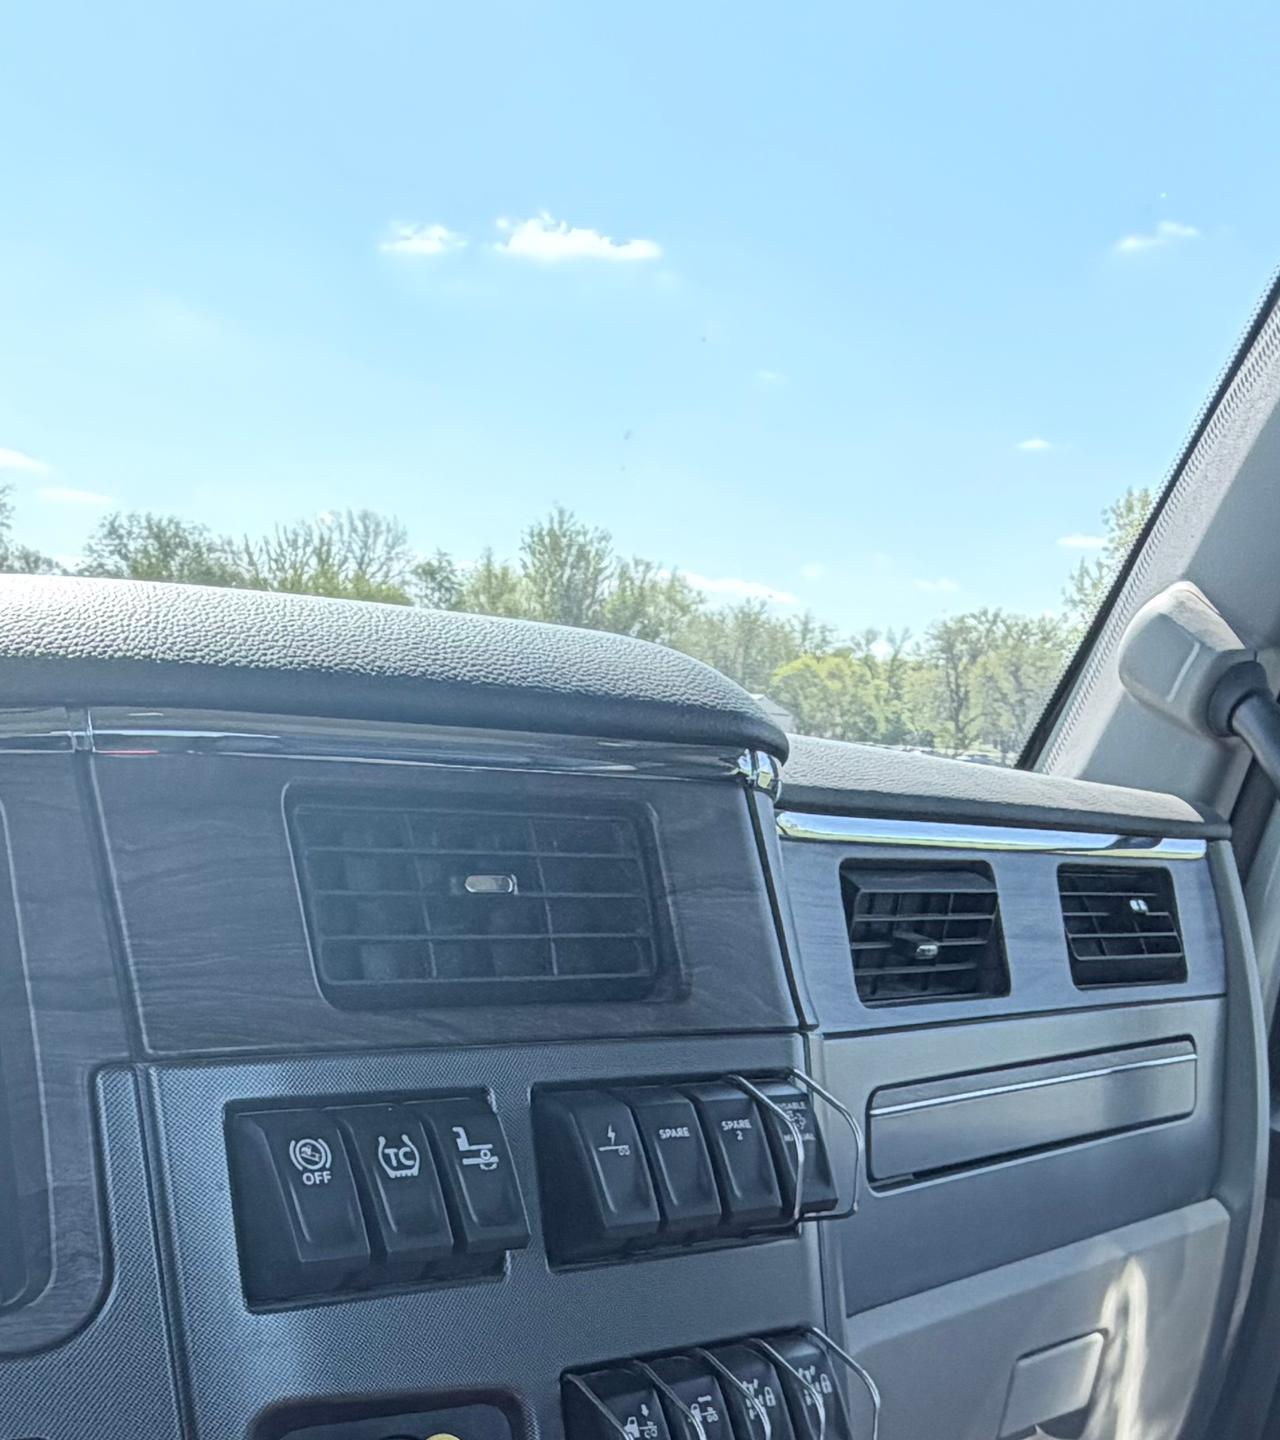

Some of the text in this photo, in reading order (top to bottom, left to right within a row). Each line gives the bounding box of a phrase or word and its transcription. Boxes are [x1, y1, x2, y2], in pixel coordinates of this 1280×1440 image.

[721, 1118, 752, 1131] SPARE
[658, 1126, 691, 1140] SPARE
[736, 1130, 745, 1141] 2
[383, 1146, 415, 1167] TC
[302, 1170, 332, 1185] OFF
